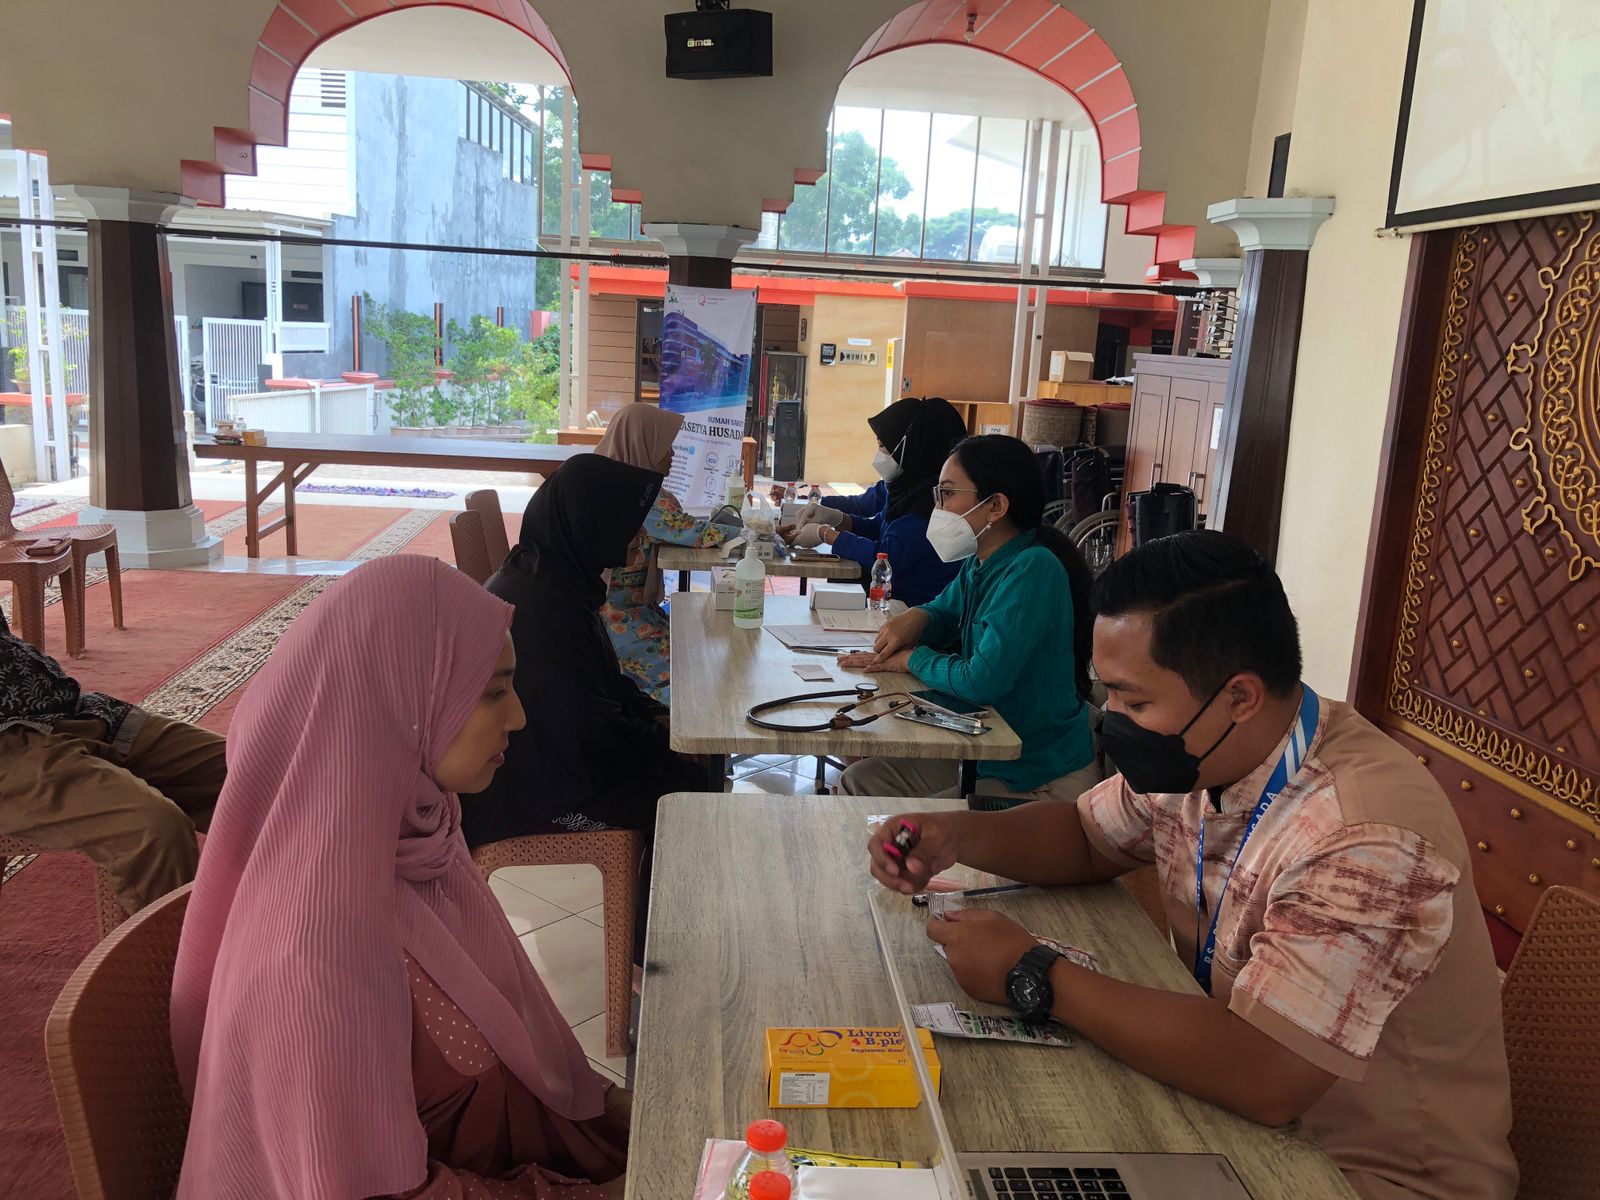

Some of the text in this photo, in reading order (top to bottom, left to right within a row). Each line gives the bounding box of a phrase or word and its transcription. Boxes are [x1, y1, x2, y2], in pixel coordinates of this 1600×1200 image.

[846, 353, 868, 361] WOMEN
[681, 421, 707, 435] ASETYA
[847, 1029, 901, 1038] Livron
[865, 1037, 903, 1047] B.ple
